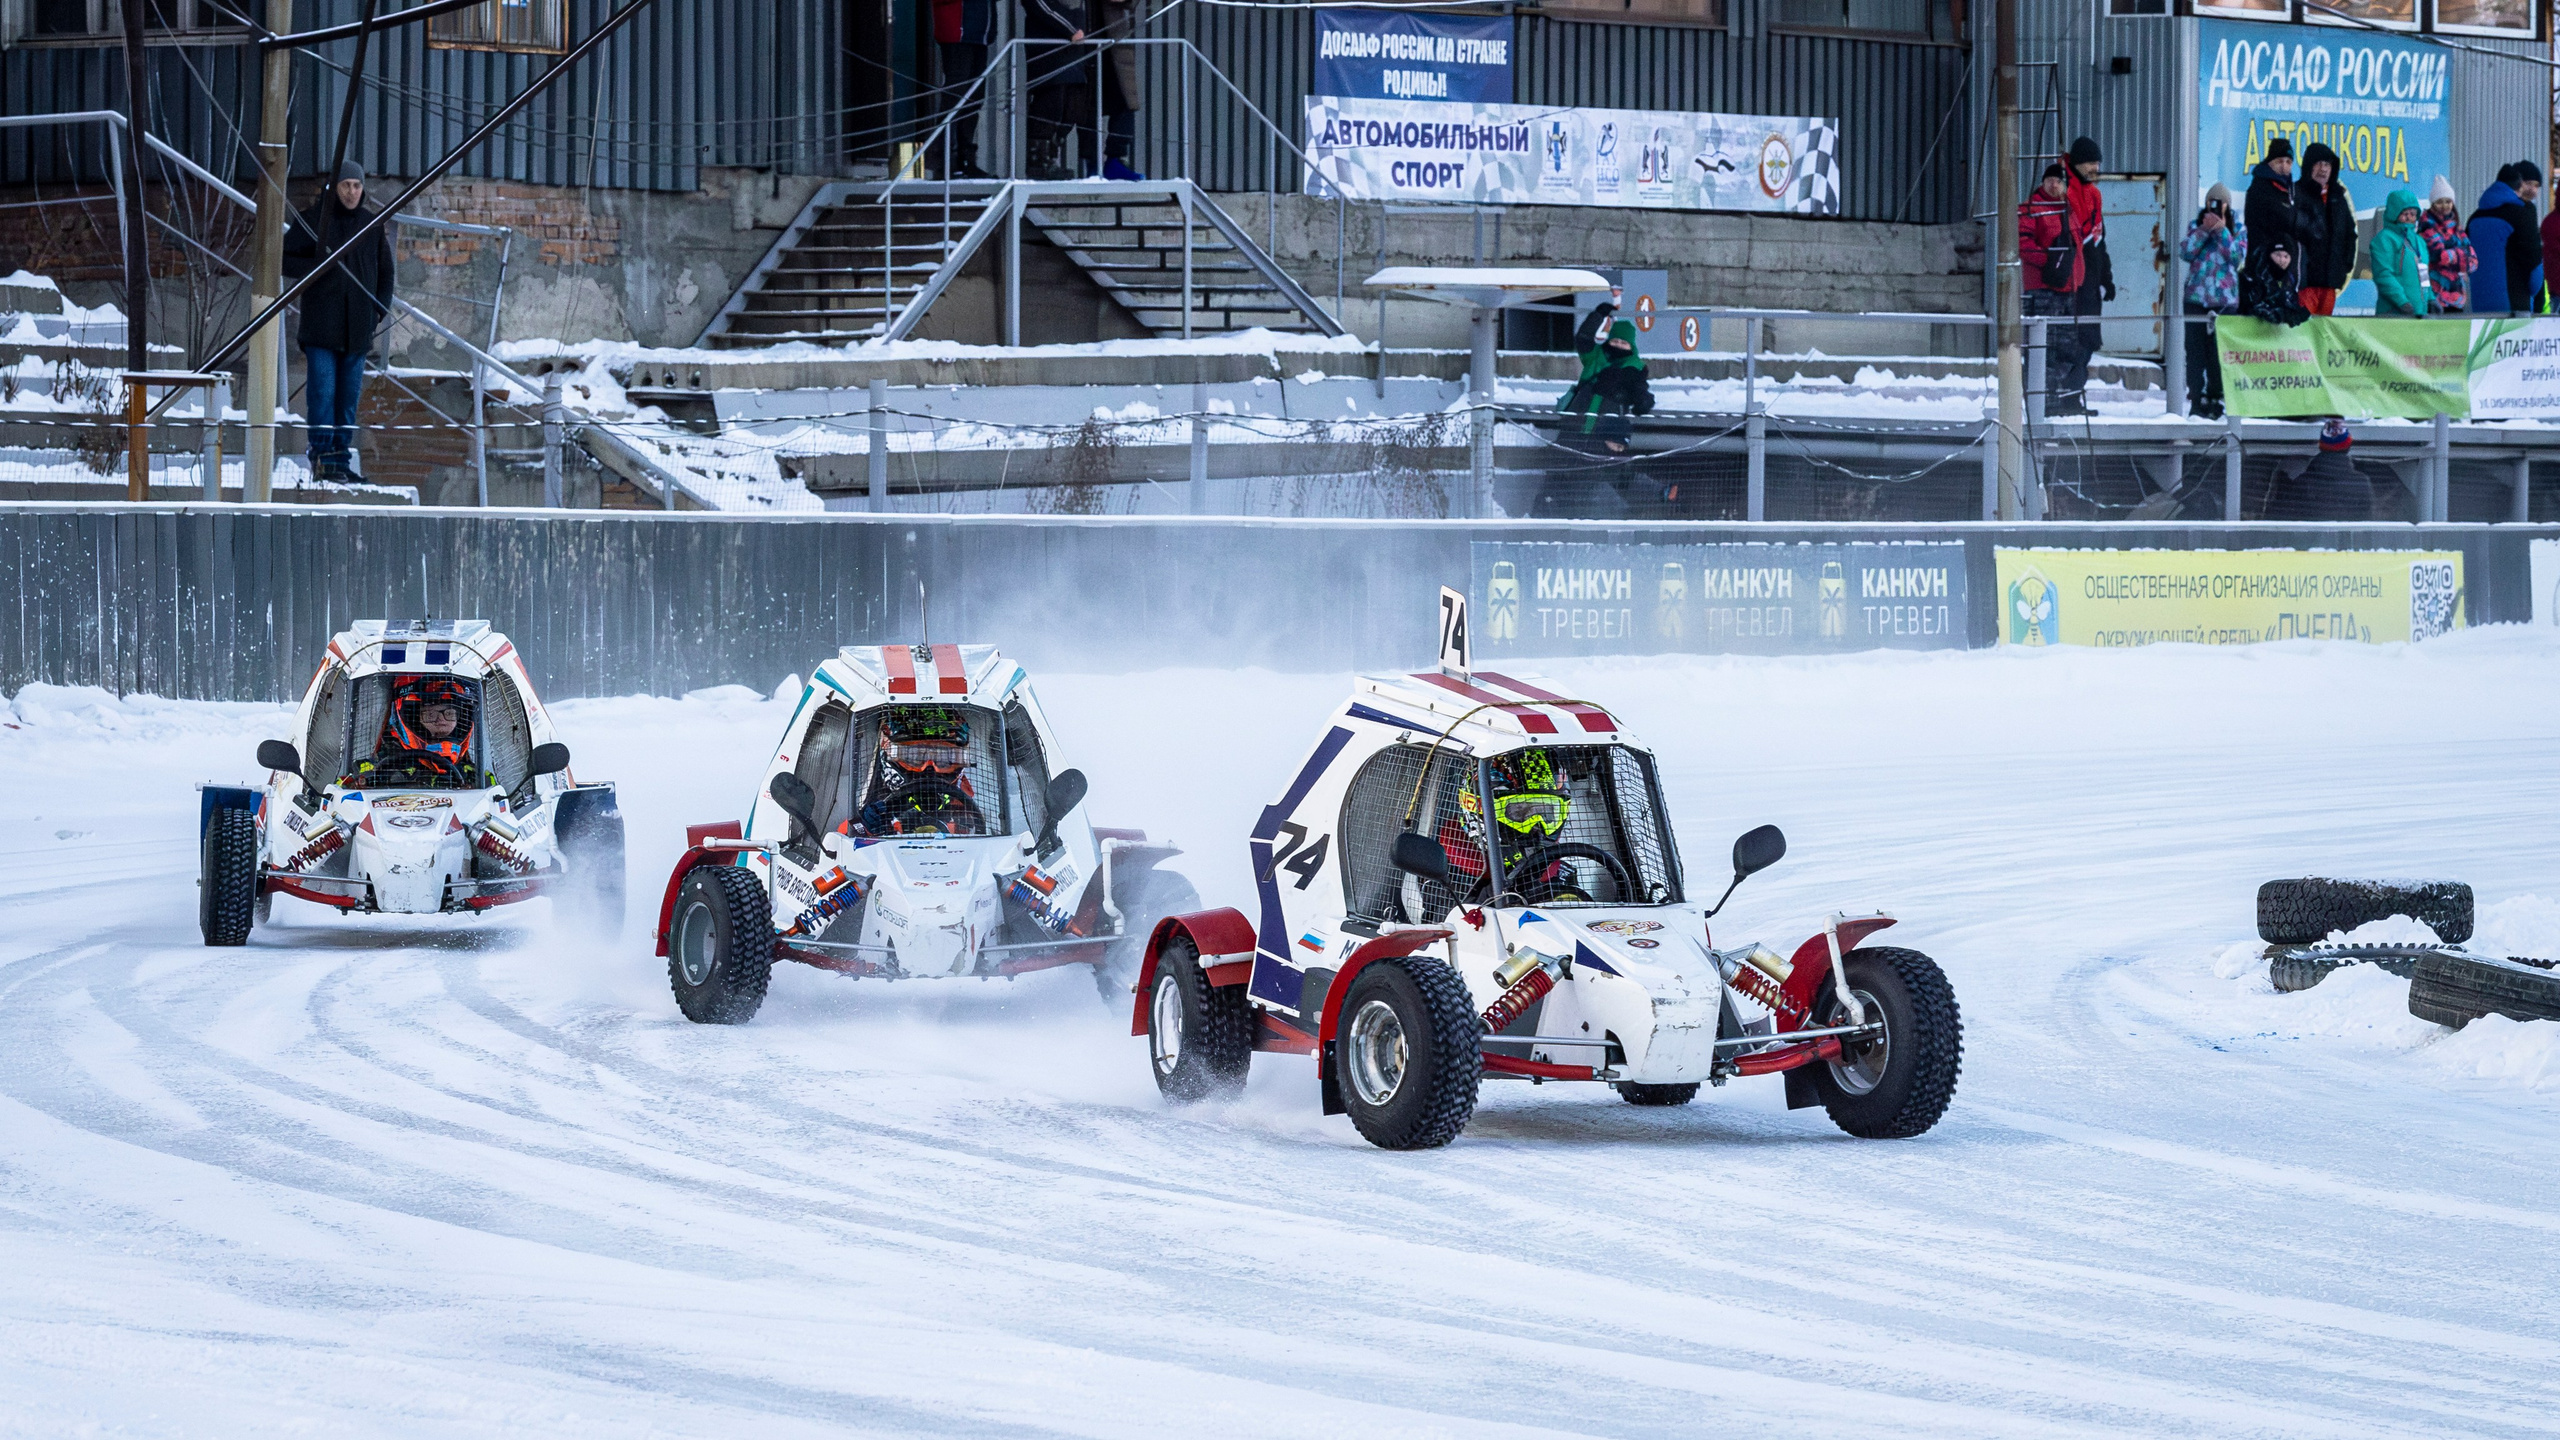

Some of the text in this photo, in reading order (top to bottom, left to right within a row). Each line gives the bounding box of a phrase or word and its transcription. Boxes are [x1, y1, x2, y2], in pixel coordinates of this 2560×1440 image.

[1320, 30, 1381, 59] ДОСААФ
[1436, 36, 1455, 63] НА
[1456, 38, 1508, 66] СТРАЖЕ
[1382, 69, 1447, 98] РОДИНЫ!
[2208, 38, 2332, 108] ДОСААФ
[2336, 46, 2448, 101] РОССИИ
[1321, 118, 1530, 152] АВТОМОБИЛЬНЫЙ
[1391, 160, 1465, 188] СПОРТ
[1640, 297, 1651, 329] 1
[1685, 317, 1698, 348] 3
[1537, 567, 1632, 600] КАНКУН
[1703, 567, 1793, 599] КАНКУН
[1861, 567, 1948, 598] КАНКУН
[2084, 574, 2382, 604] ОБЩЕСТВЕННАЯ ОРГАНИЗАЦИЯ ОХРАНЫ
[1440, 594, 1466, 667] 74
[1537, 607, 1632, 639] ТРЕВЕЛ
[1703, 606, 1793, 637] ТРЕВЕЛ
[1862, 605, 1949, 635] ТРЕВЕЛ
[1261, 819, 1331, 891] 74
